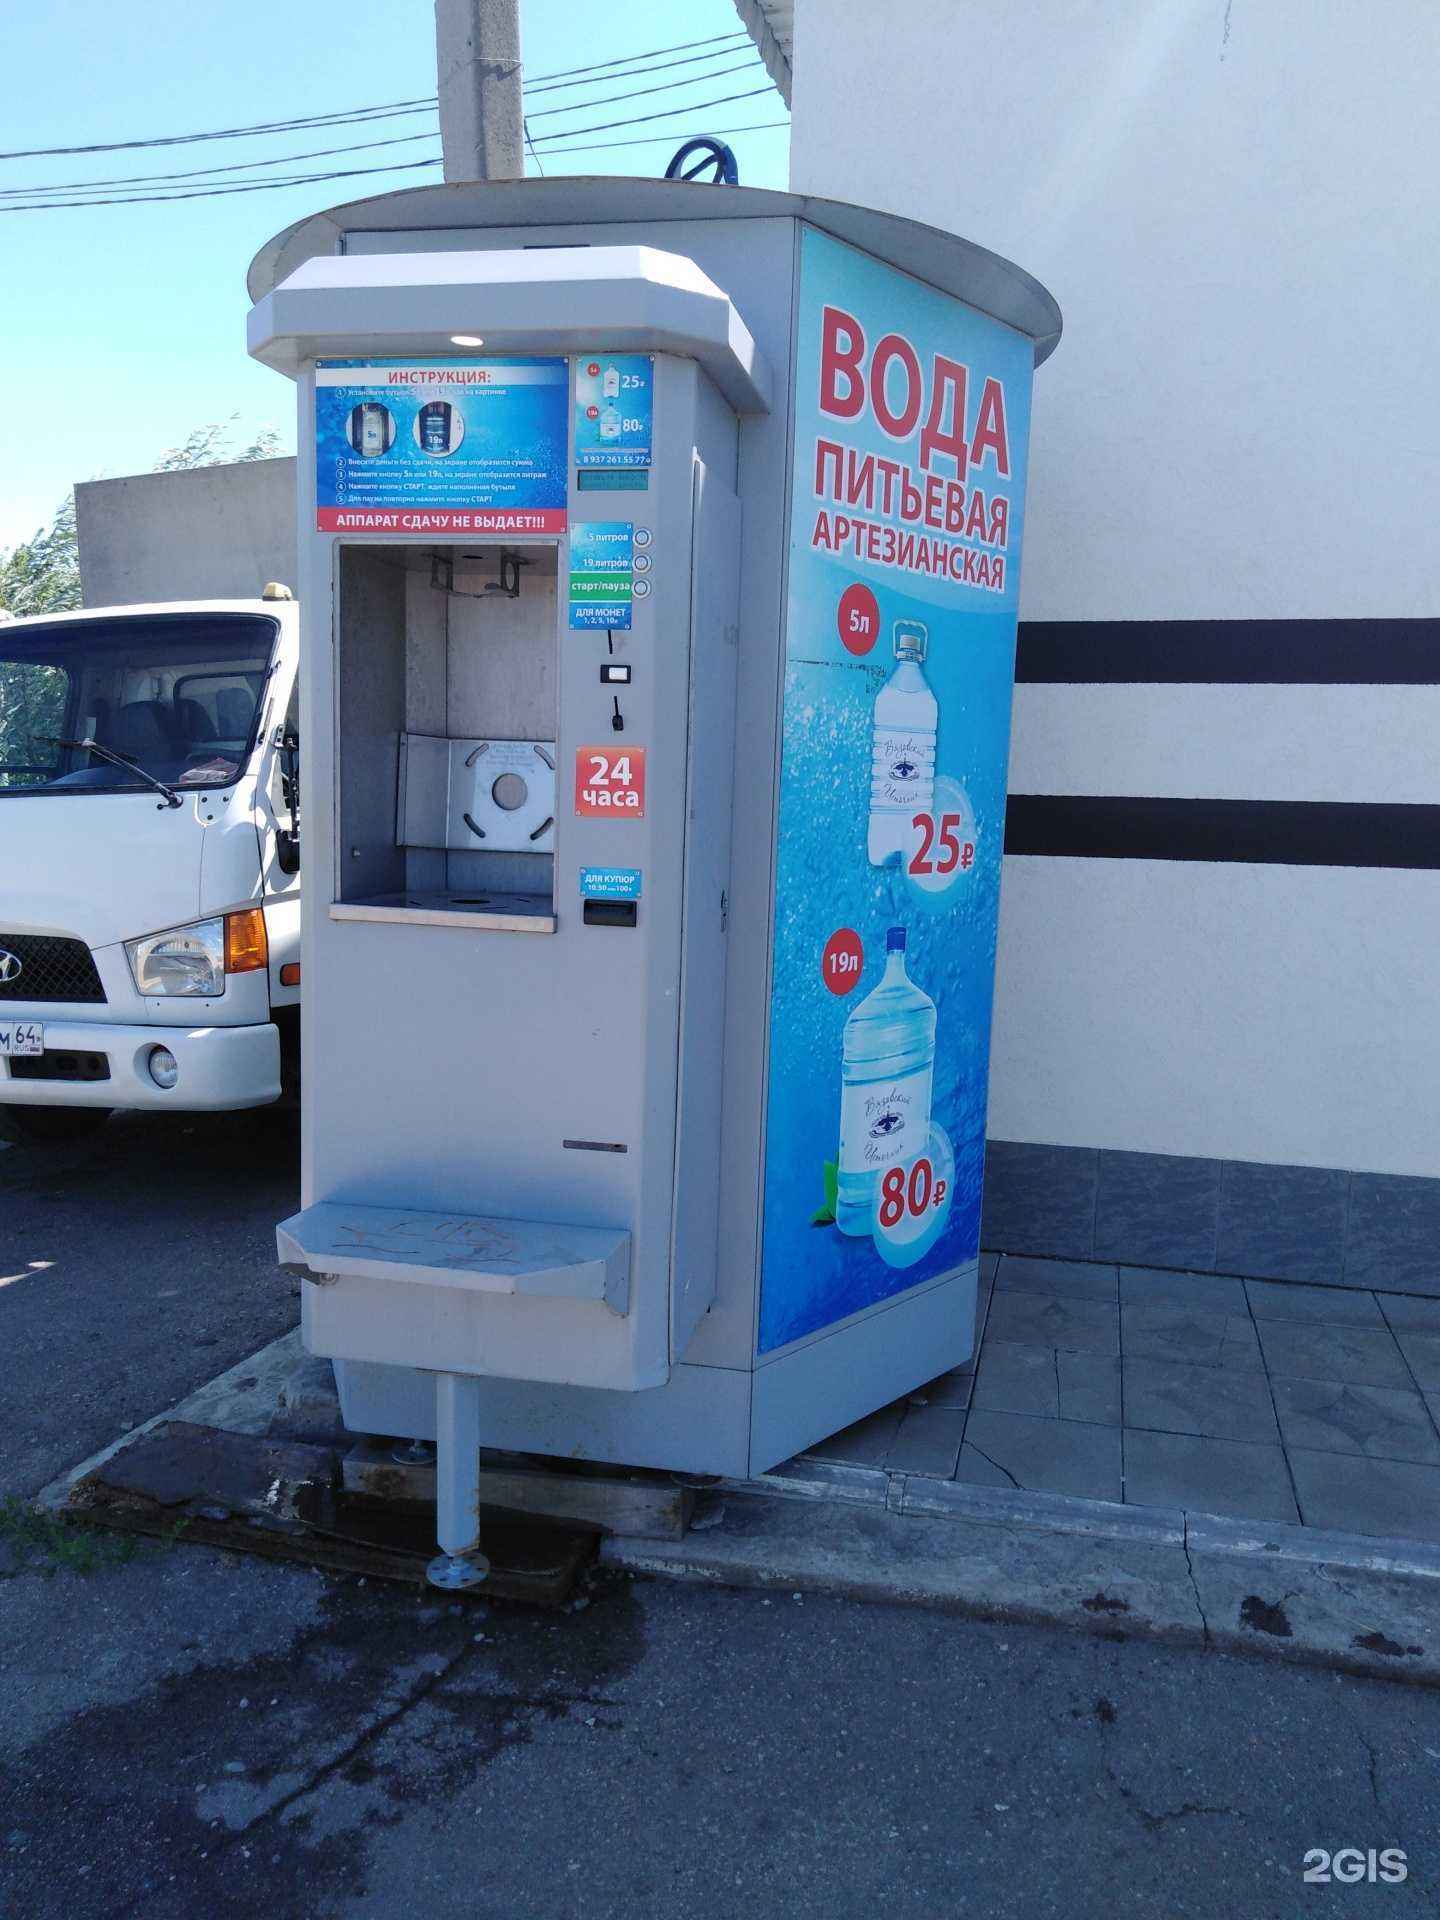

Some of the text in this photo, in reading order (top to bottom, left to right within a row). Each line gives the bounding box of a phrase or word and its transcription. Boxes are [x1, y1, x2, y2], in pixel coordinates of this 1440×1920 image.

[388, 371, 492, 385] ИНСТРУКЦИЯ:
[819, 305, 1010, 482] ВОДА
[814, 439, 1009, 547] ПИТЬЕВАЯ
[336, 515, 546, 530] АППАРАТ СДАЧУ НЕ ВЫДАЕТ!!!
[596, 534, 628, 543] литров
[811, 511, 1005, 592] АРТЕЗИАНСКАЯ
[595, 560, 628, 569] литров
[571, 582, 631, 592] старт/пауза
[575, 608, 626, 617] ДЛЯ МОНЕТ
[849, 609, 870, 634] 5л
[588, 756, 633, 786] 24
[582, 789, 640, 807] часа
[584, 874, 635, 884] ДЛЯ КУПЮР
[829, 951, 859, 974] 19л
[15, 1025, 36, 1044] 64
